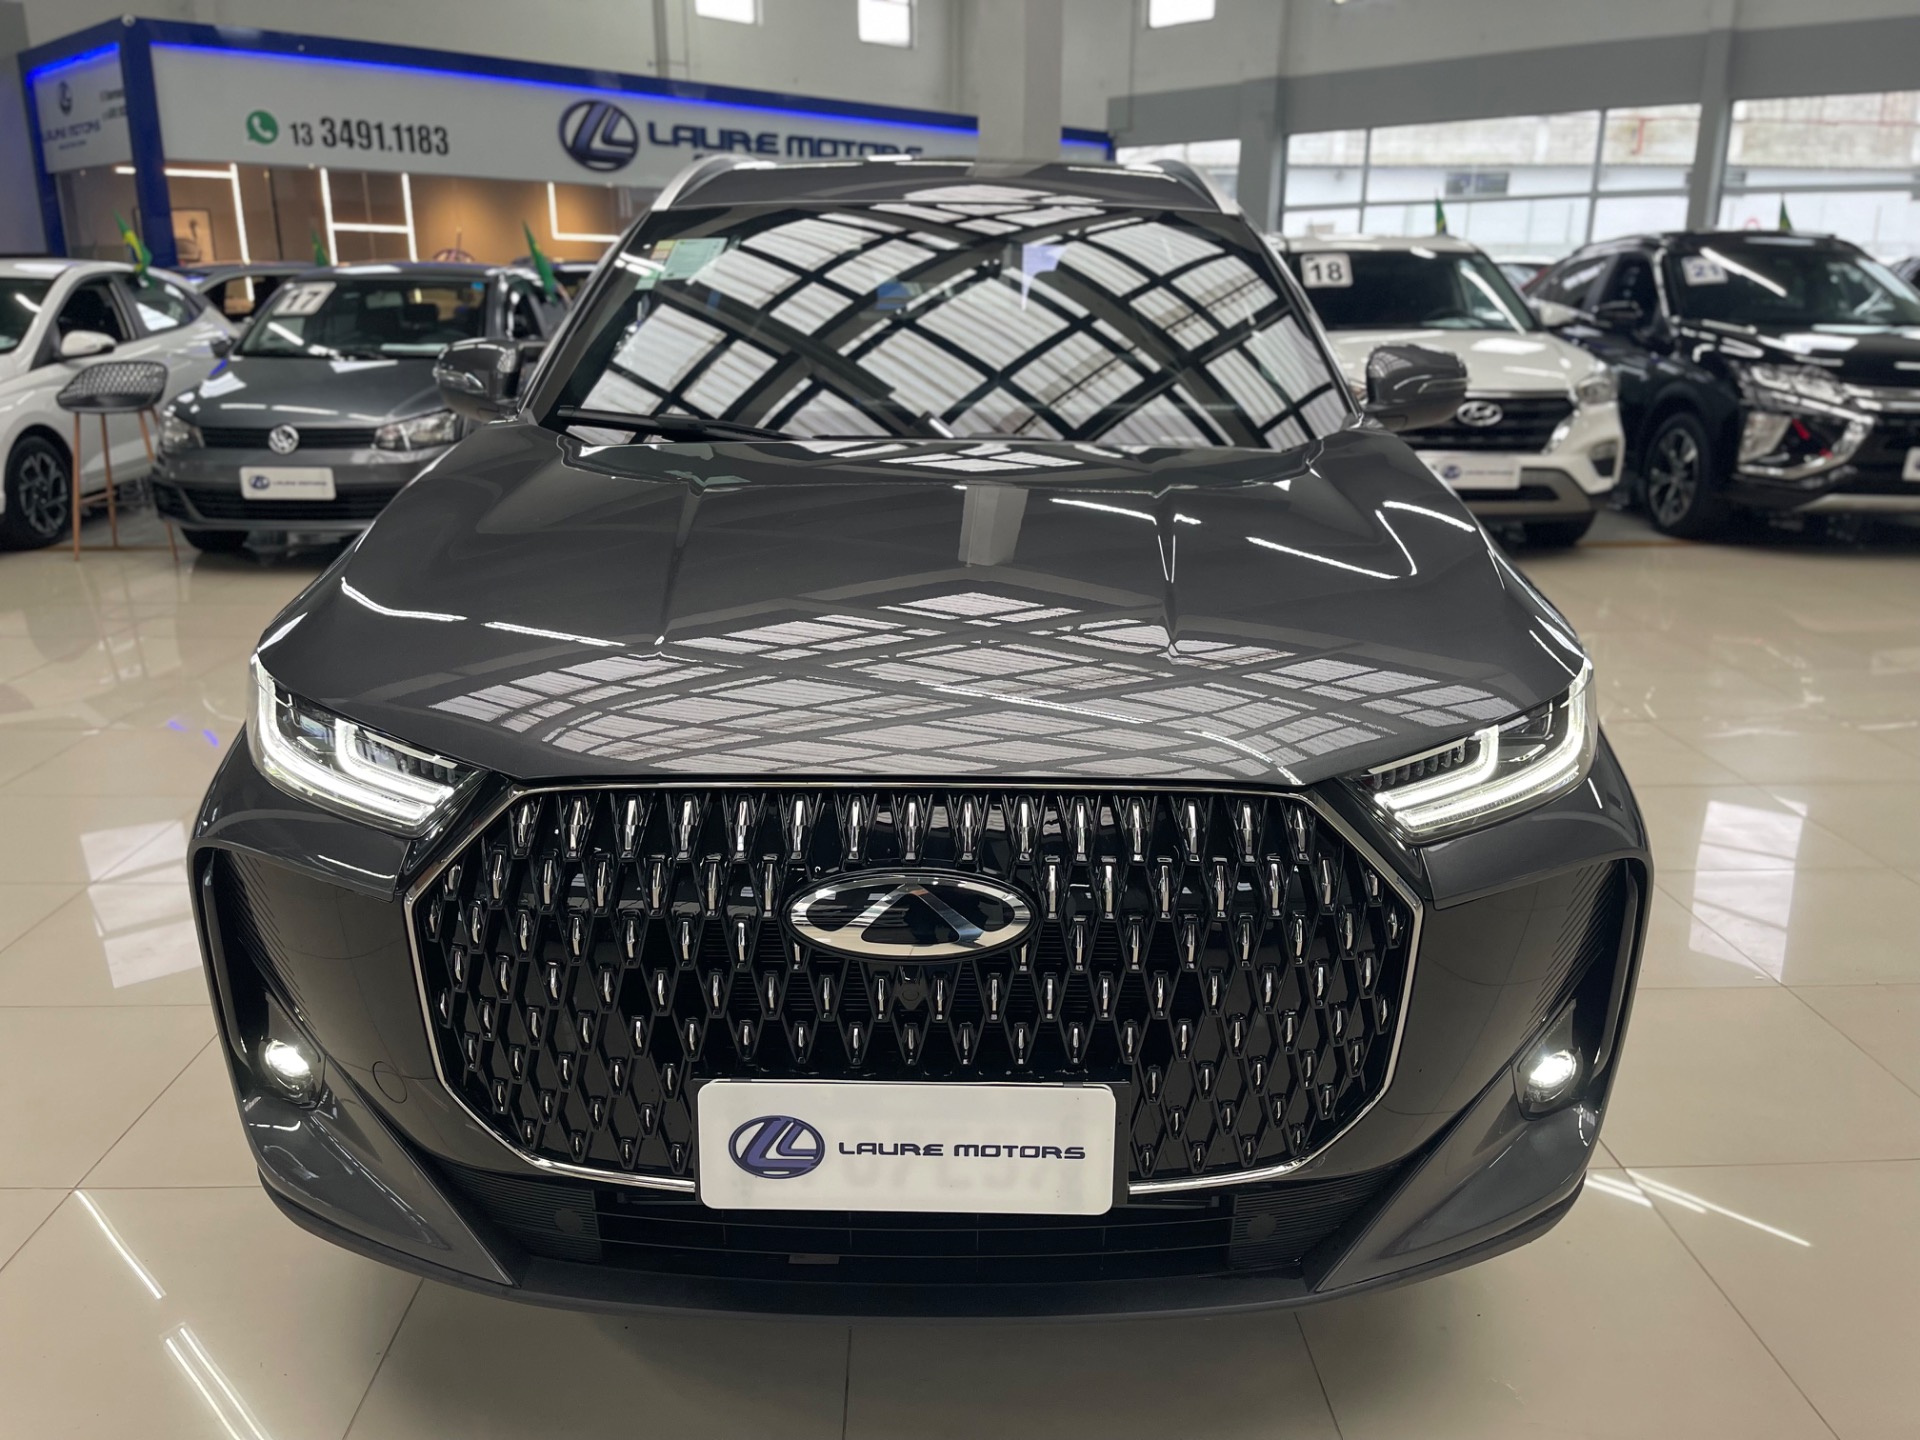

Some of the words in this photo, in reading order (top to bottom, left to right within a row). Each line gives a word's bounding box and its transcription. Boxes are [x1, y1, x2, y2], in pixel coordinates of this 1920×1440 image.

[289, 121, 314, 147] 13
[320, 116, 449, 156] 3491.1183
[647, 121, 779, 155] LAURE
[1310, 262, 1343, 282] 18
[838, 1141, 944, 1157] LAURE
[953, 1143, 1086, 1160] MOTORS
